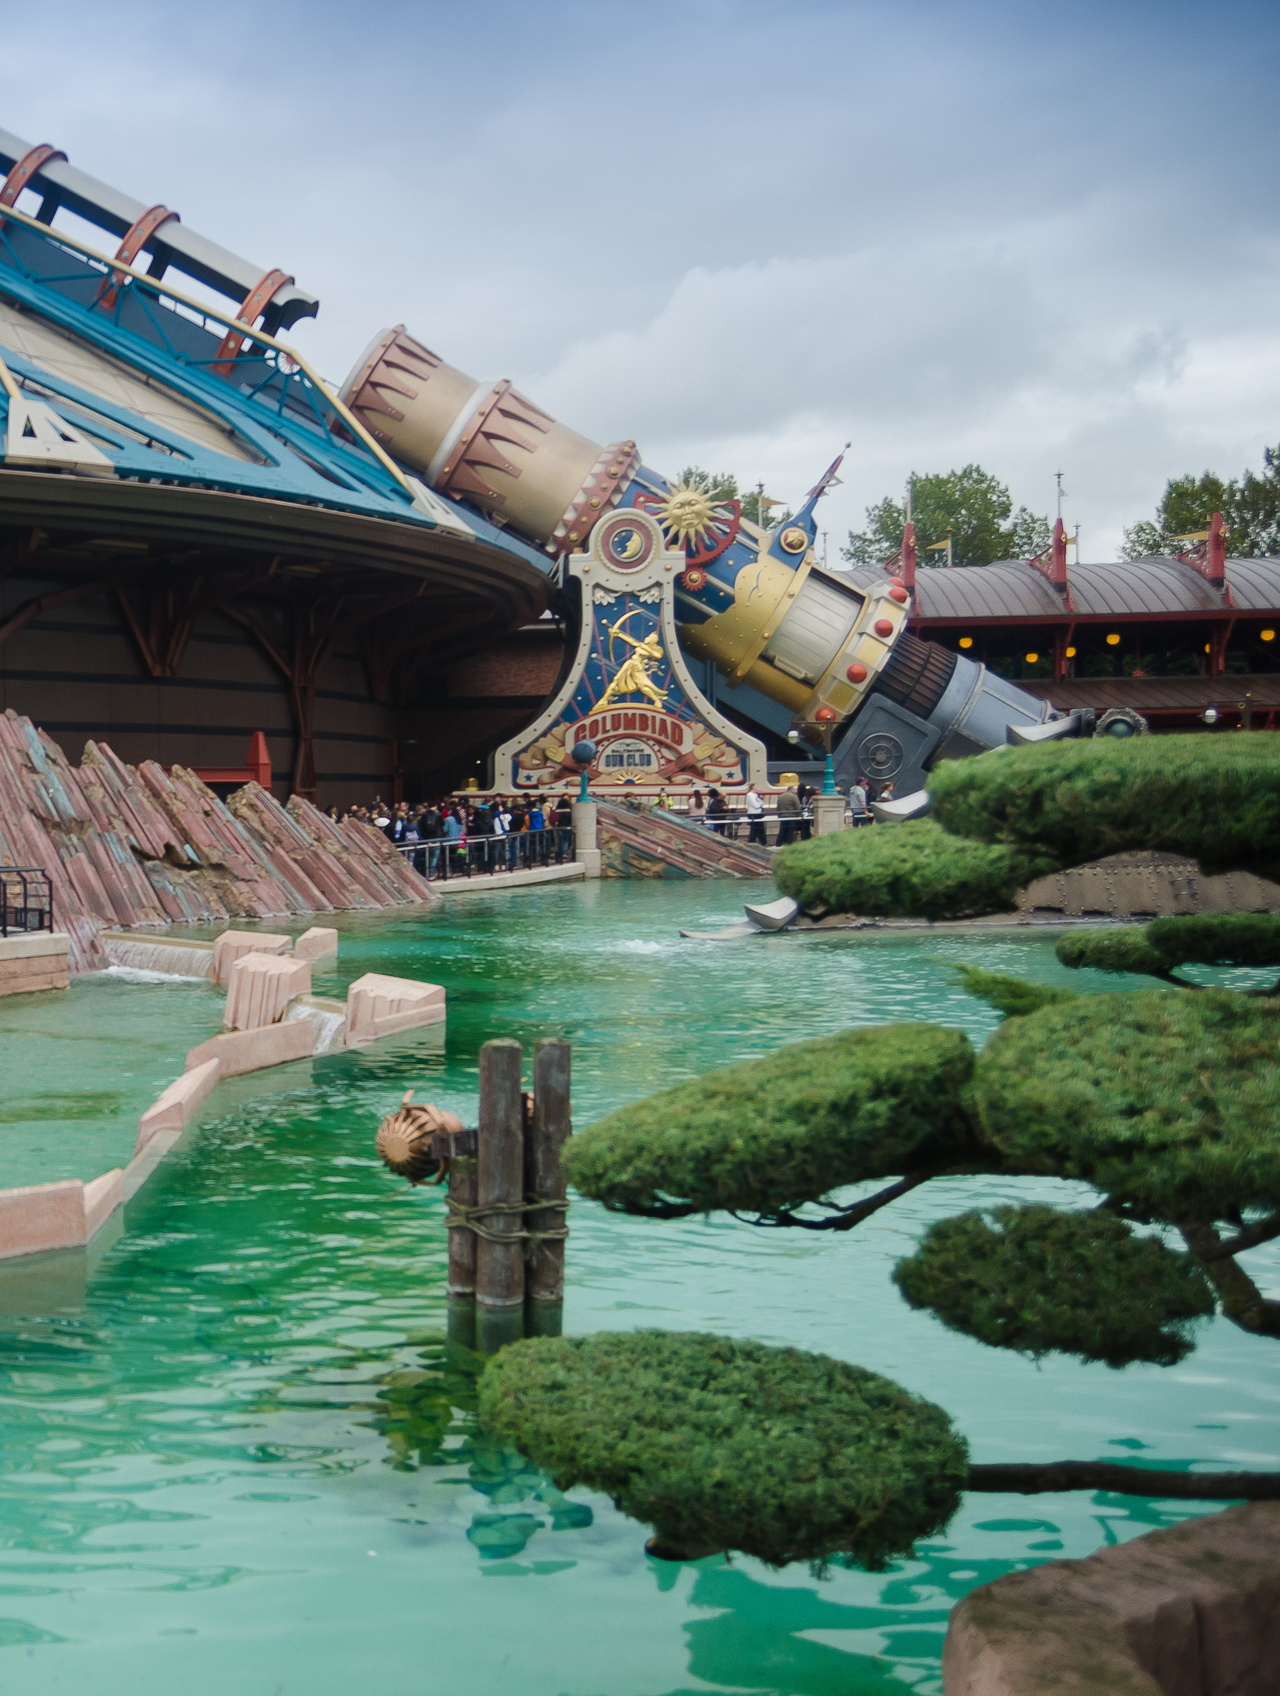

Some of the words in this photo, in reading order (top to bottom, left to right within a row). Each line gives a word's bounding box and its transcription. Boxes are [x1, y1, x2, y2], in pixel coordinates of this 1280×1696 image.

[574, 712, 684, 746] COLUMBIAD
[605, 754, 624, 767] GUN
[627, 753, 652, 767] CLUB
